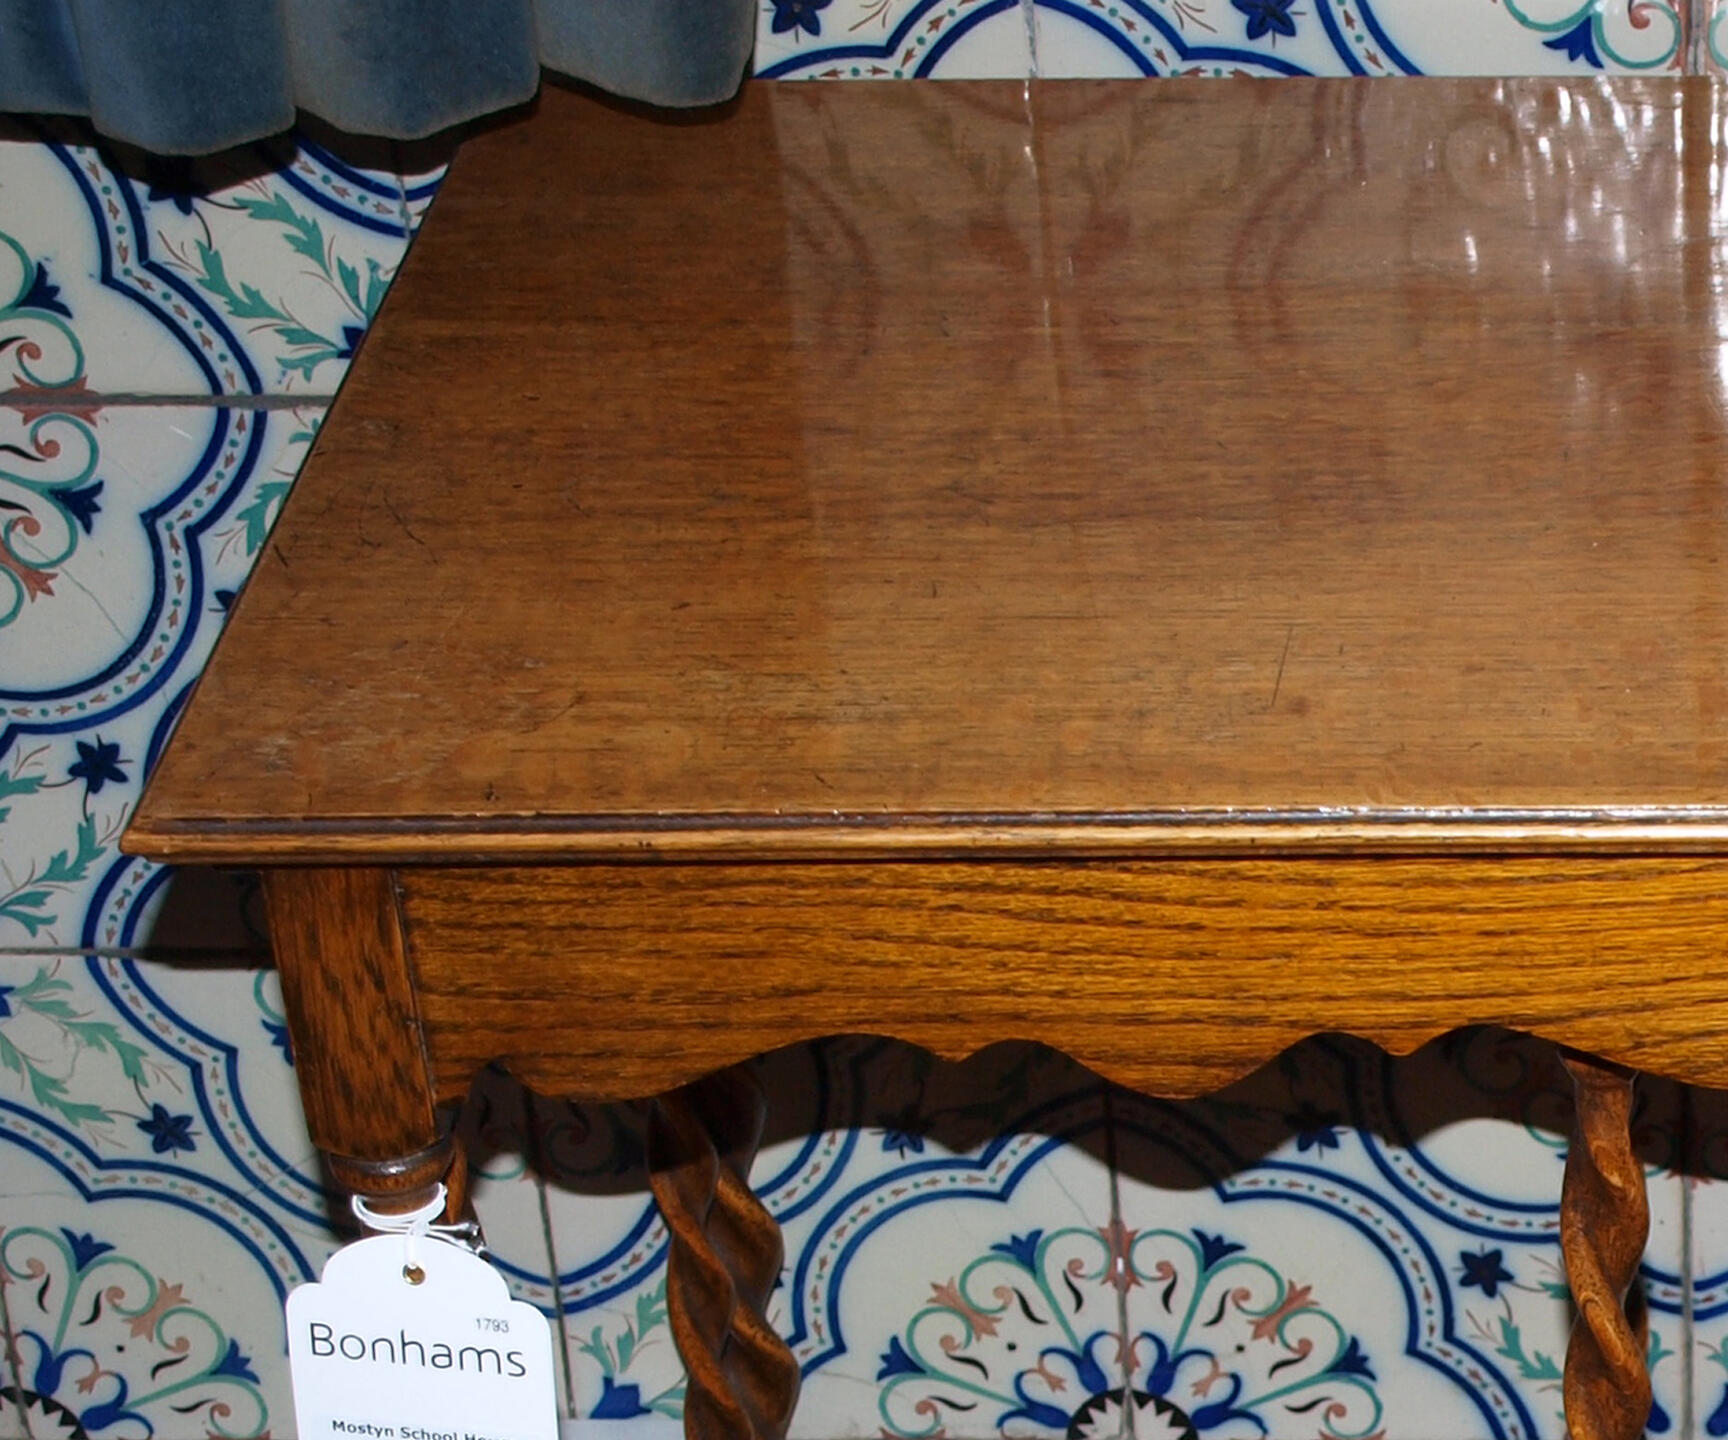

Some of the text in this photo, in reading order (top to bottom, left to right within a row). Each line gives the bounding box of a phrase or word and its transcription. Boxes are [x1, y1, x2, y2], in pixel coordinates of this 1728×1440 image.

[476, 1318, 509, 1333] 1793
[310, 1322, 526, 1377] Bonhams
[332, 1420, 394, 1438] Mostyn
